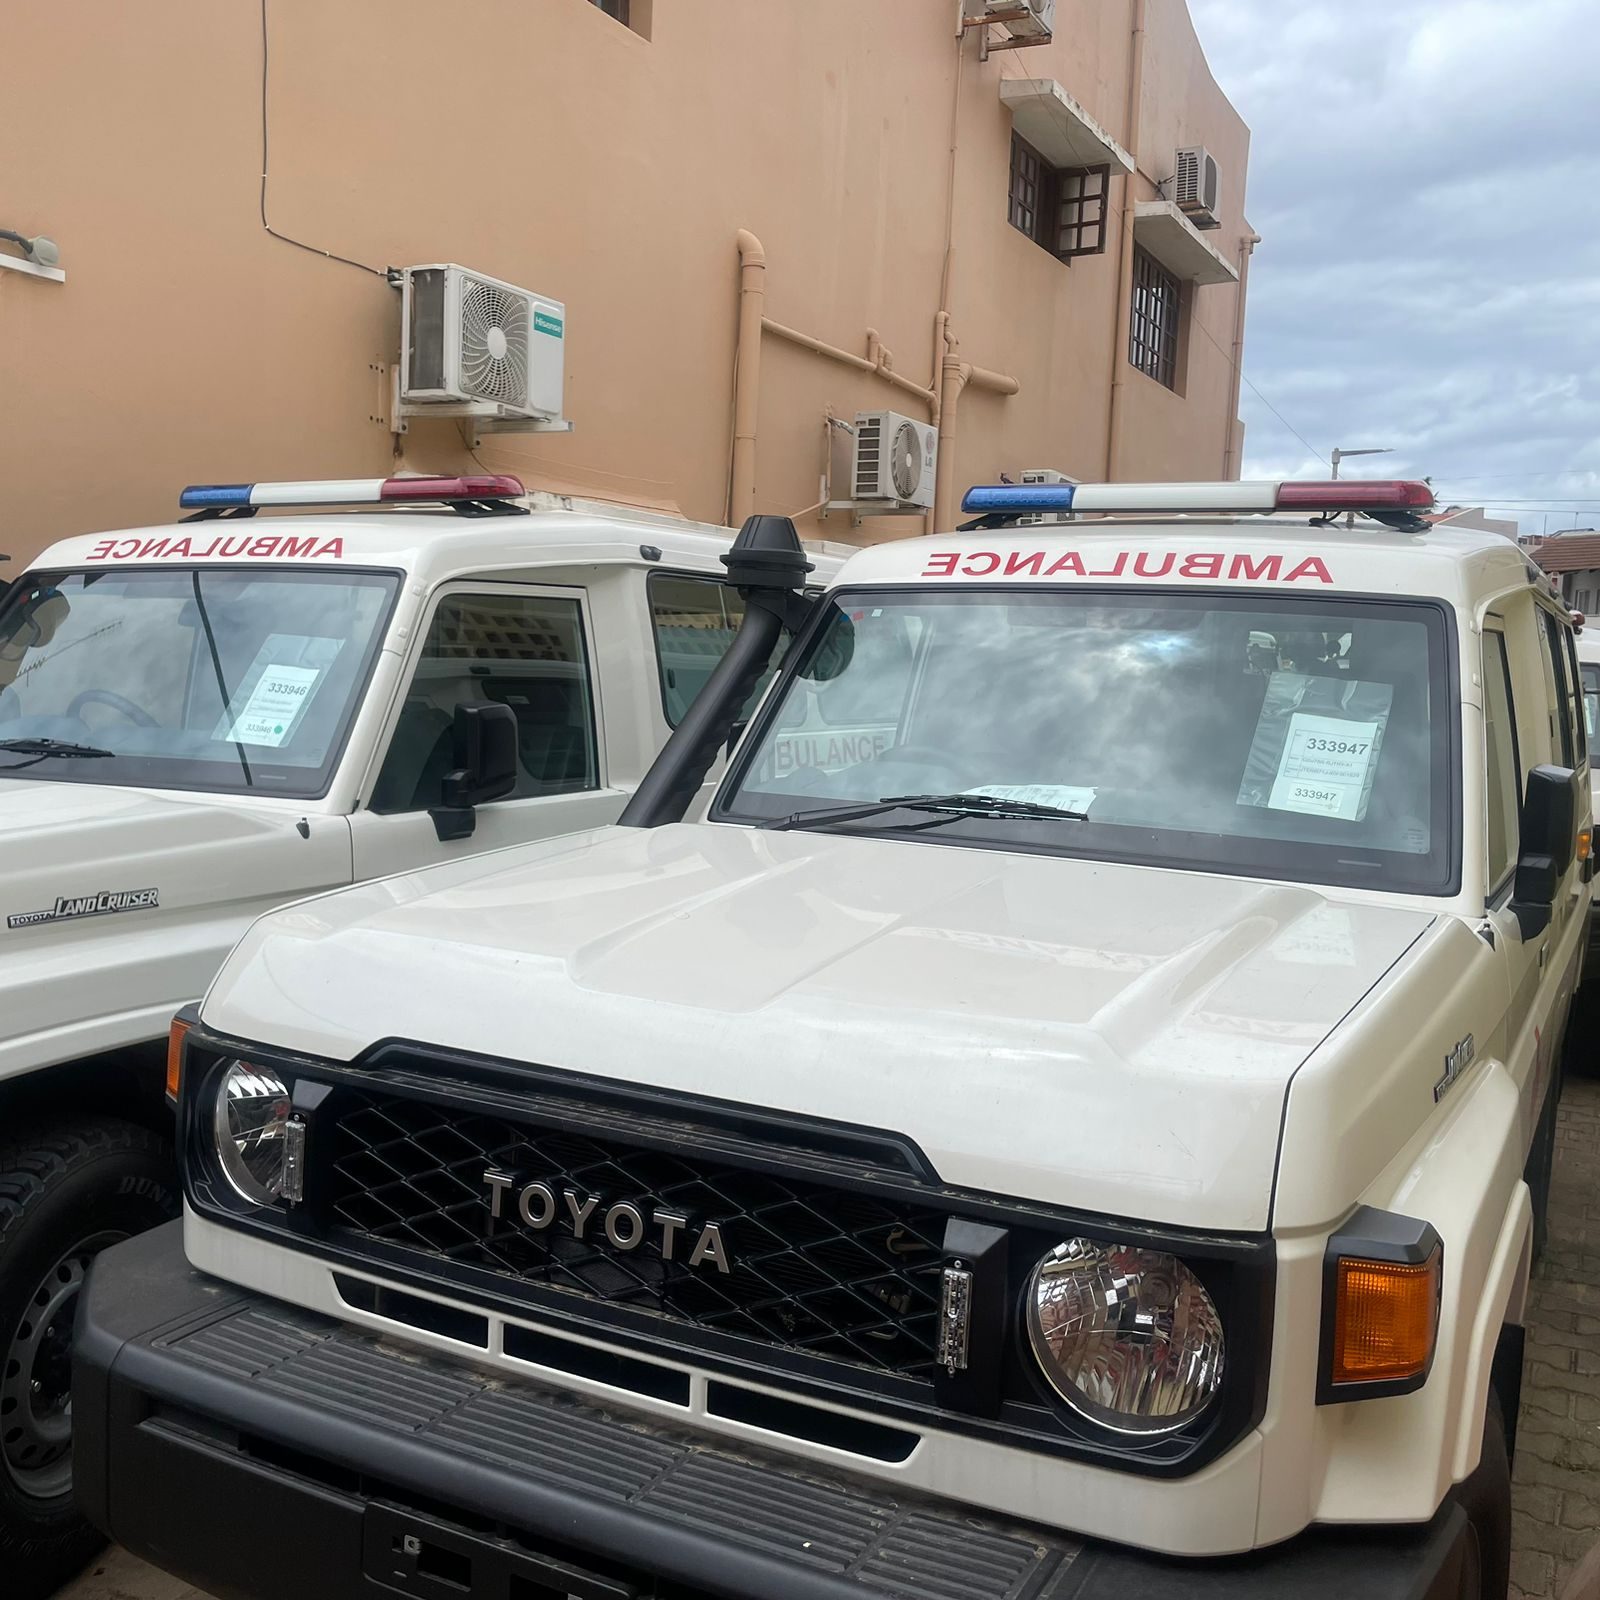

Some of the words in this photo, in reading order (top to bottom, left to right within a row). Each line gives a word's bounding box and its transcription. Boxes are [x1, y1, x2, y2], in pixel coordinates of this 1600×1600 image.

[268, 682, 308, 695] 333946
[1307, 737, 1368, 755] 333947
[1295, 788, 1336, 801] 333947
[12, 912, 55, 925] TOYOTA
[483, 1170, 730, 1274] TOYOTA
